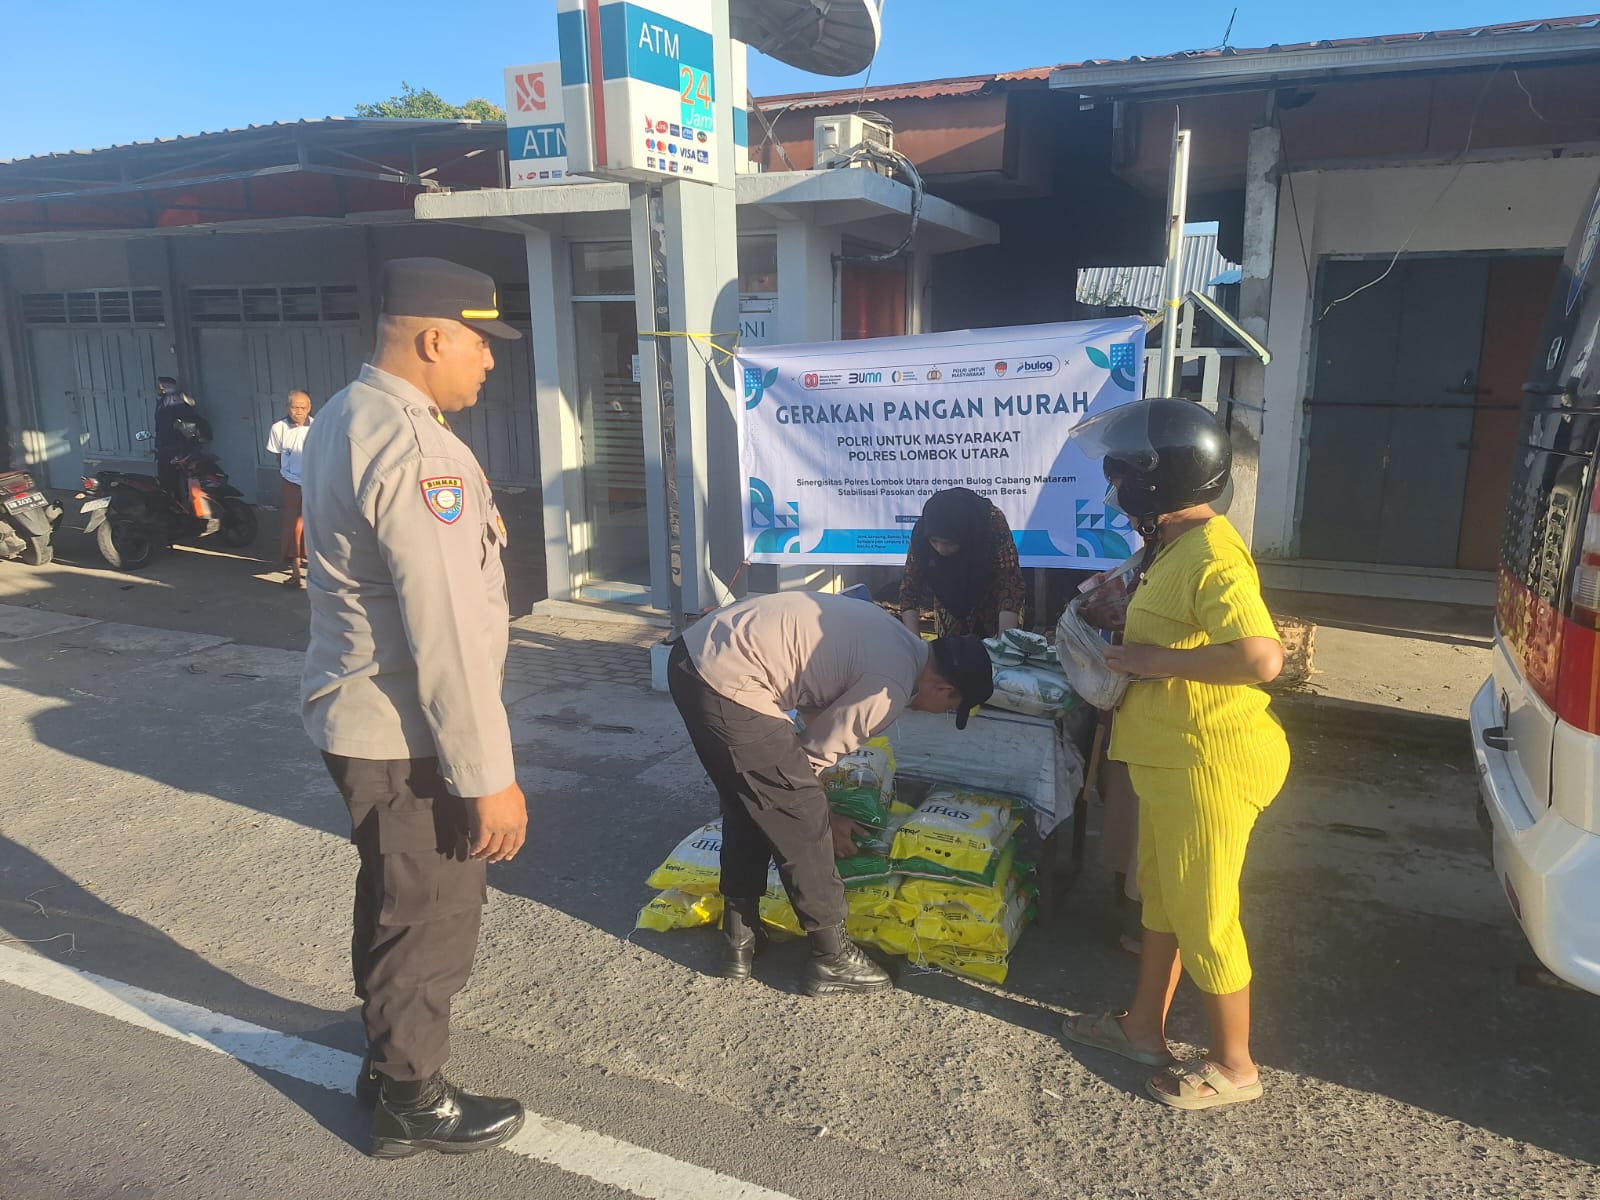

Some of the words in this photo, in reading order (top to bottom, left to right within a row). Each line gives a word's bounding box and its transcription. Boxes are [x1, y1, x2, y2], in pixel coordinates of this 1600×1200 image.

[638, 21, 680, 61] ATM
[680, 66, 712, 109] 24
[684, 107, 714, 132] Jam
[680, 147, 696, 160] VISA
[1024, 360, 1053, 371] bulog
[775, 402, 875, 425] GERAKAN
[883, 397, 984, 421] PANGAN
[994, 391, 1089, 417] MURAH
[837, 435, 873, 447] POLRI
[876, 434, 921, 446] UNTUK
[925, 430, 1021, 445] MASYARAKAT
[848, 450, 897, 462] POLRES
[900, 449, 958, 461] LOMBOK
[961, 447, 1010, 460] UTARA
[844, 478, 869, 486] Polres
[871, 477, 904, 486] Lombok
[905, 477, 929, 486] Utara
[931, 476, 964, 486] dengan
[966, 476, 993, 487] Bulog
[995, 475, 1031, 486] Cabang
[1033, 474, 1077, 484] Mataram
[838, 487, 878, 497] Stabilisasi
[880, 488, 915, 496] Pasokan
[917, 488, 933, 496] dan
[1000, 487, 1027, 496] Beras
[920, 805, 970, 820] SPHP
